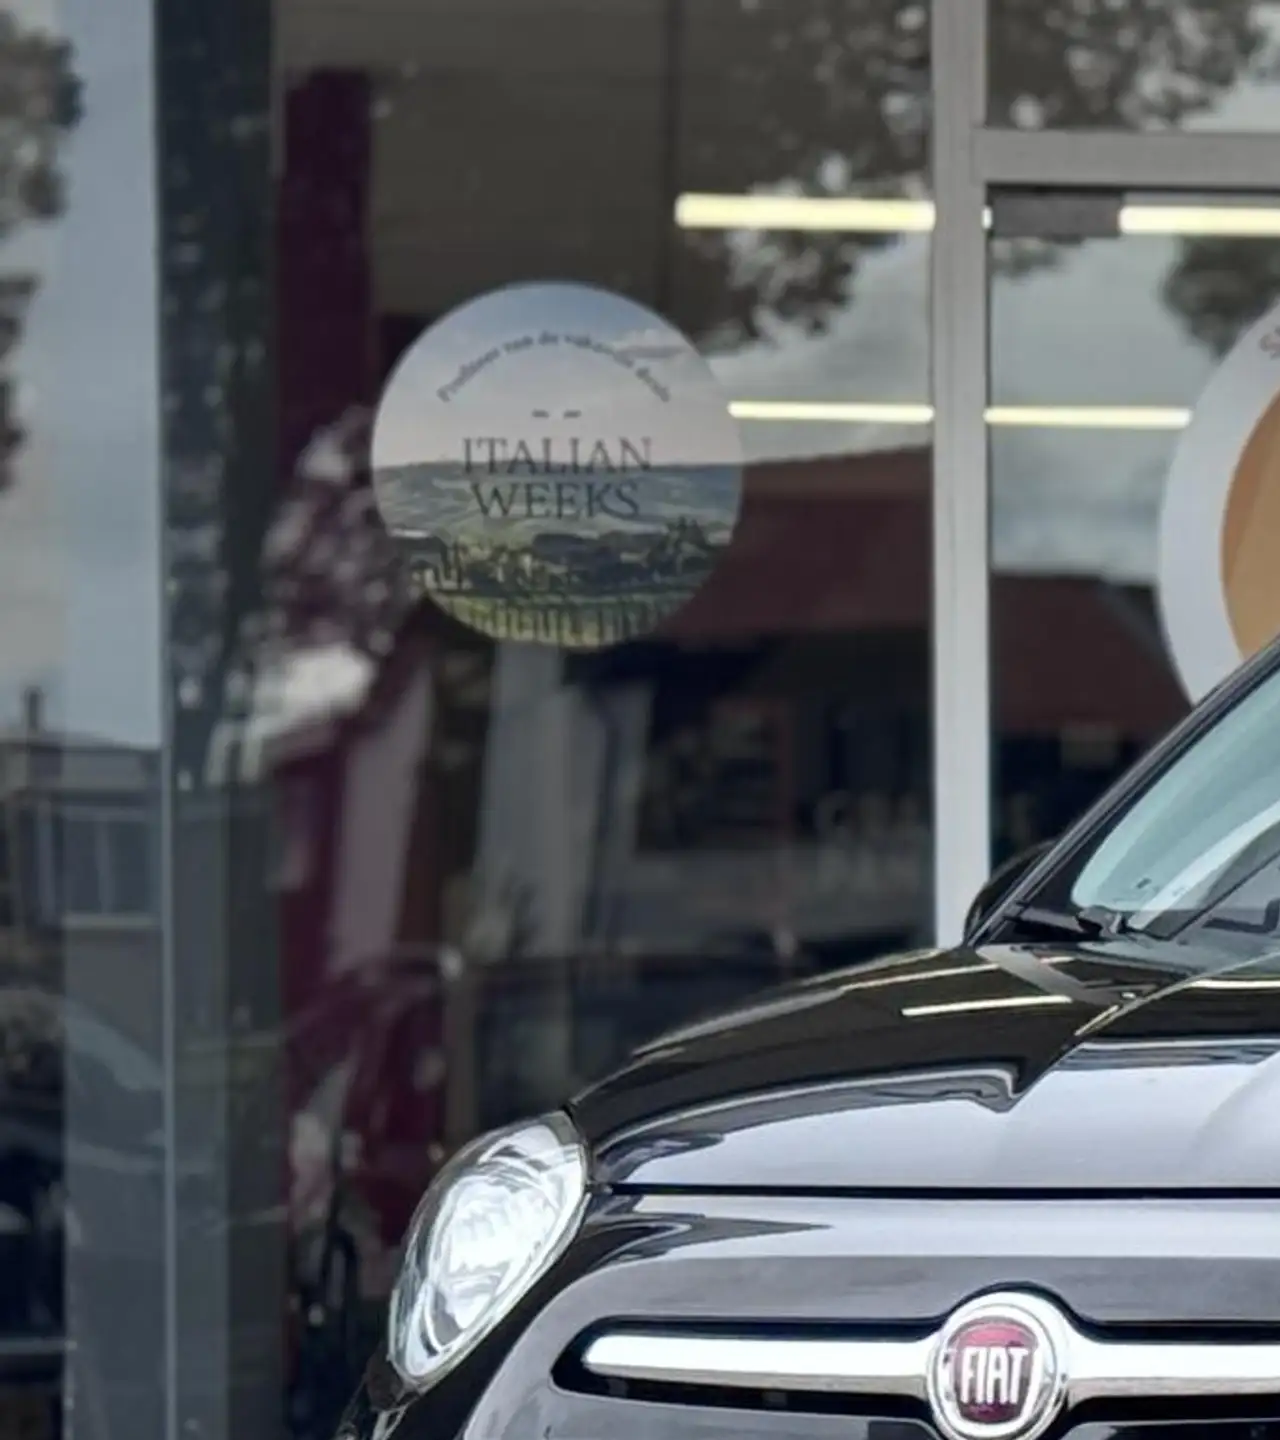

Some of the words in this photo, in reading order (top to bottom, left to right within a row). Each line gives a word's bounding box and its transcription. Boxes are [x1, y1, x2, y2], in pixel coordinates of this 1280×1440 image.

[463, 437, 653, 475] ITALIAN
[470, 482, 642, 520] WEEKS
[960, 1346, 1029, 1405] FIAT
